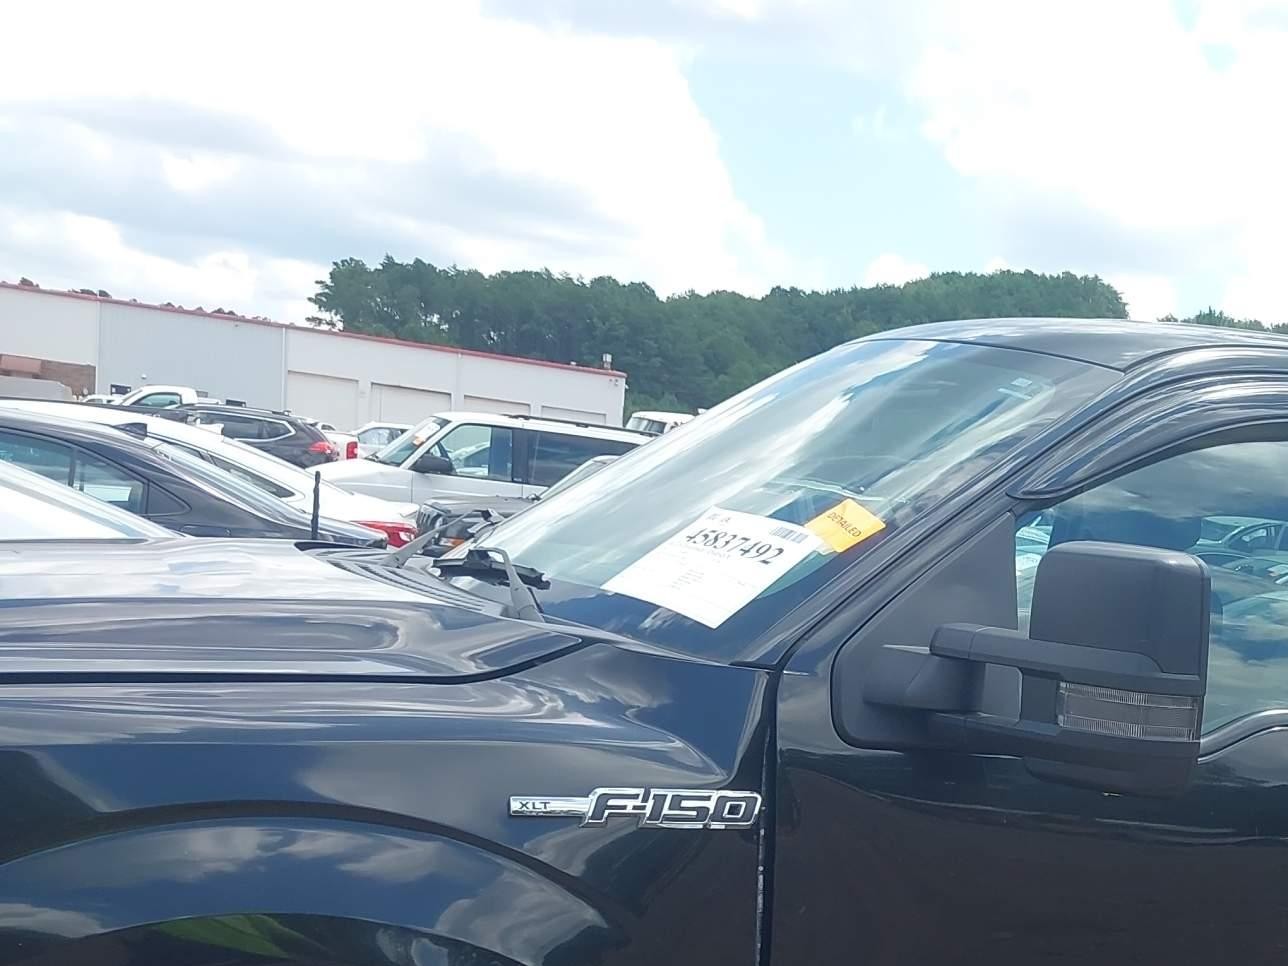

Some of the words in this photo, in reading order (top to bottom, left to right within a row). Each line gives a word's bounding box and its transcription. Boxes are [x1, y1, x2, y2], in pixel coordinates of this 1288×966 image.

[826, 511, 862, 538] DETAILED
[685, 527, 785, 566] 45837492
[517, 800, 550, 811] XLT
[579, 787, 762, 829] F-150
